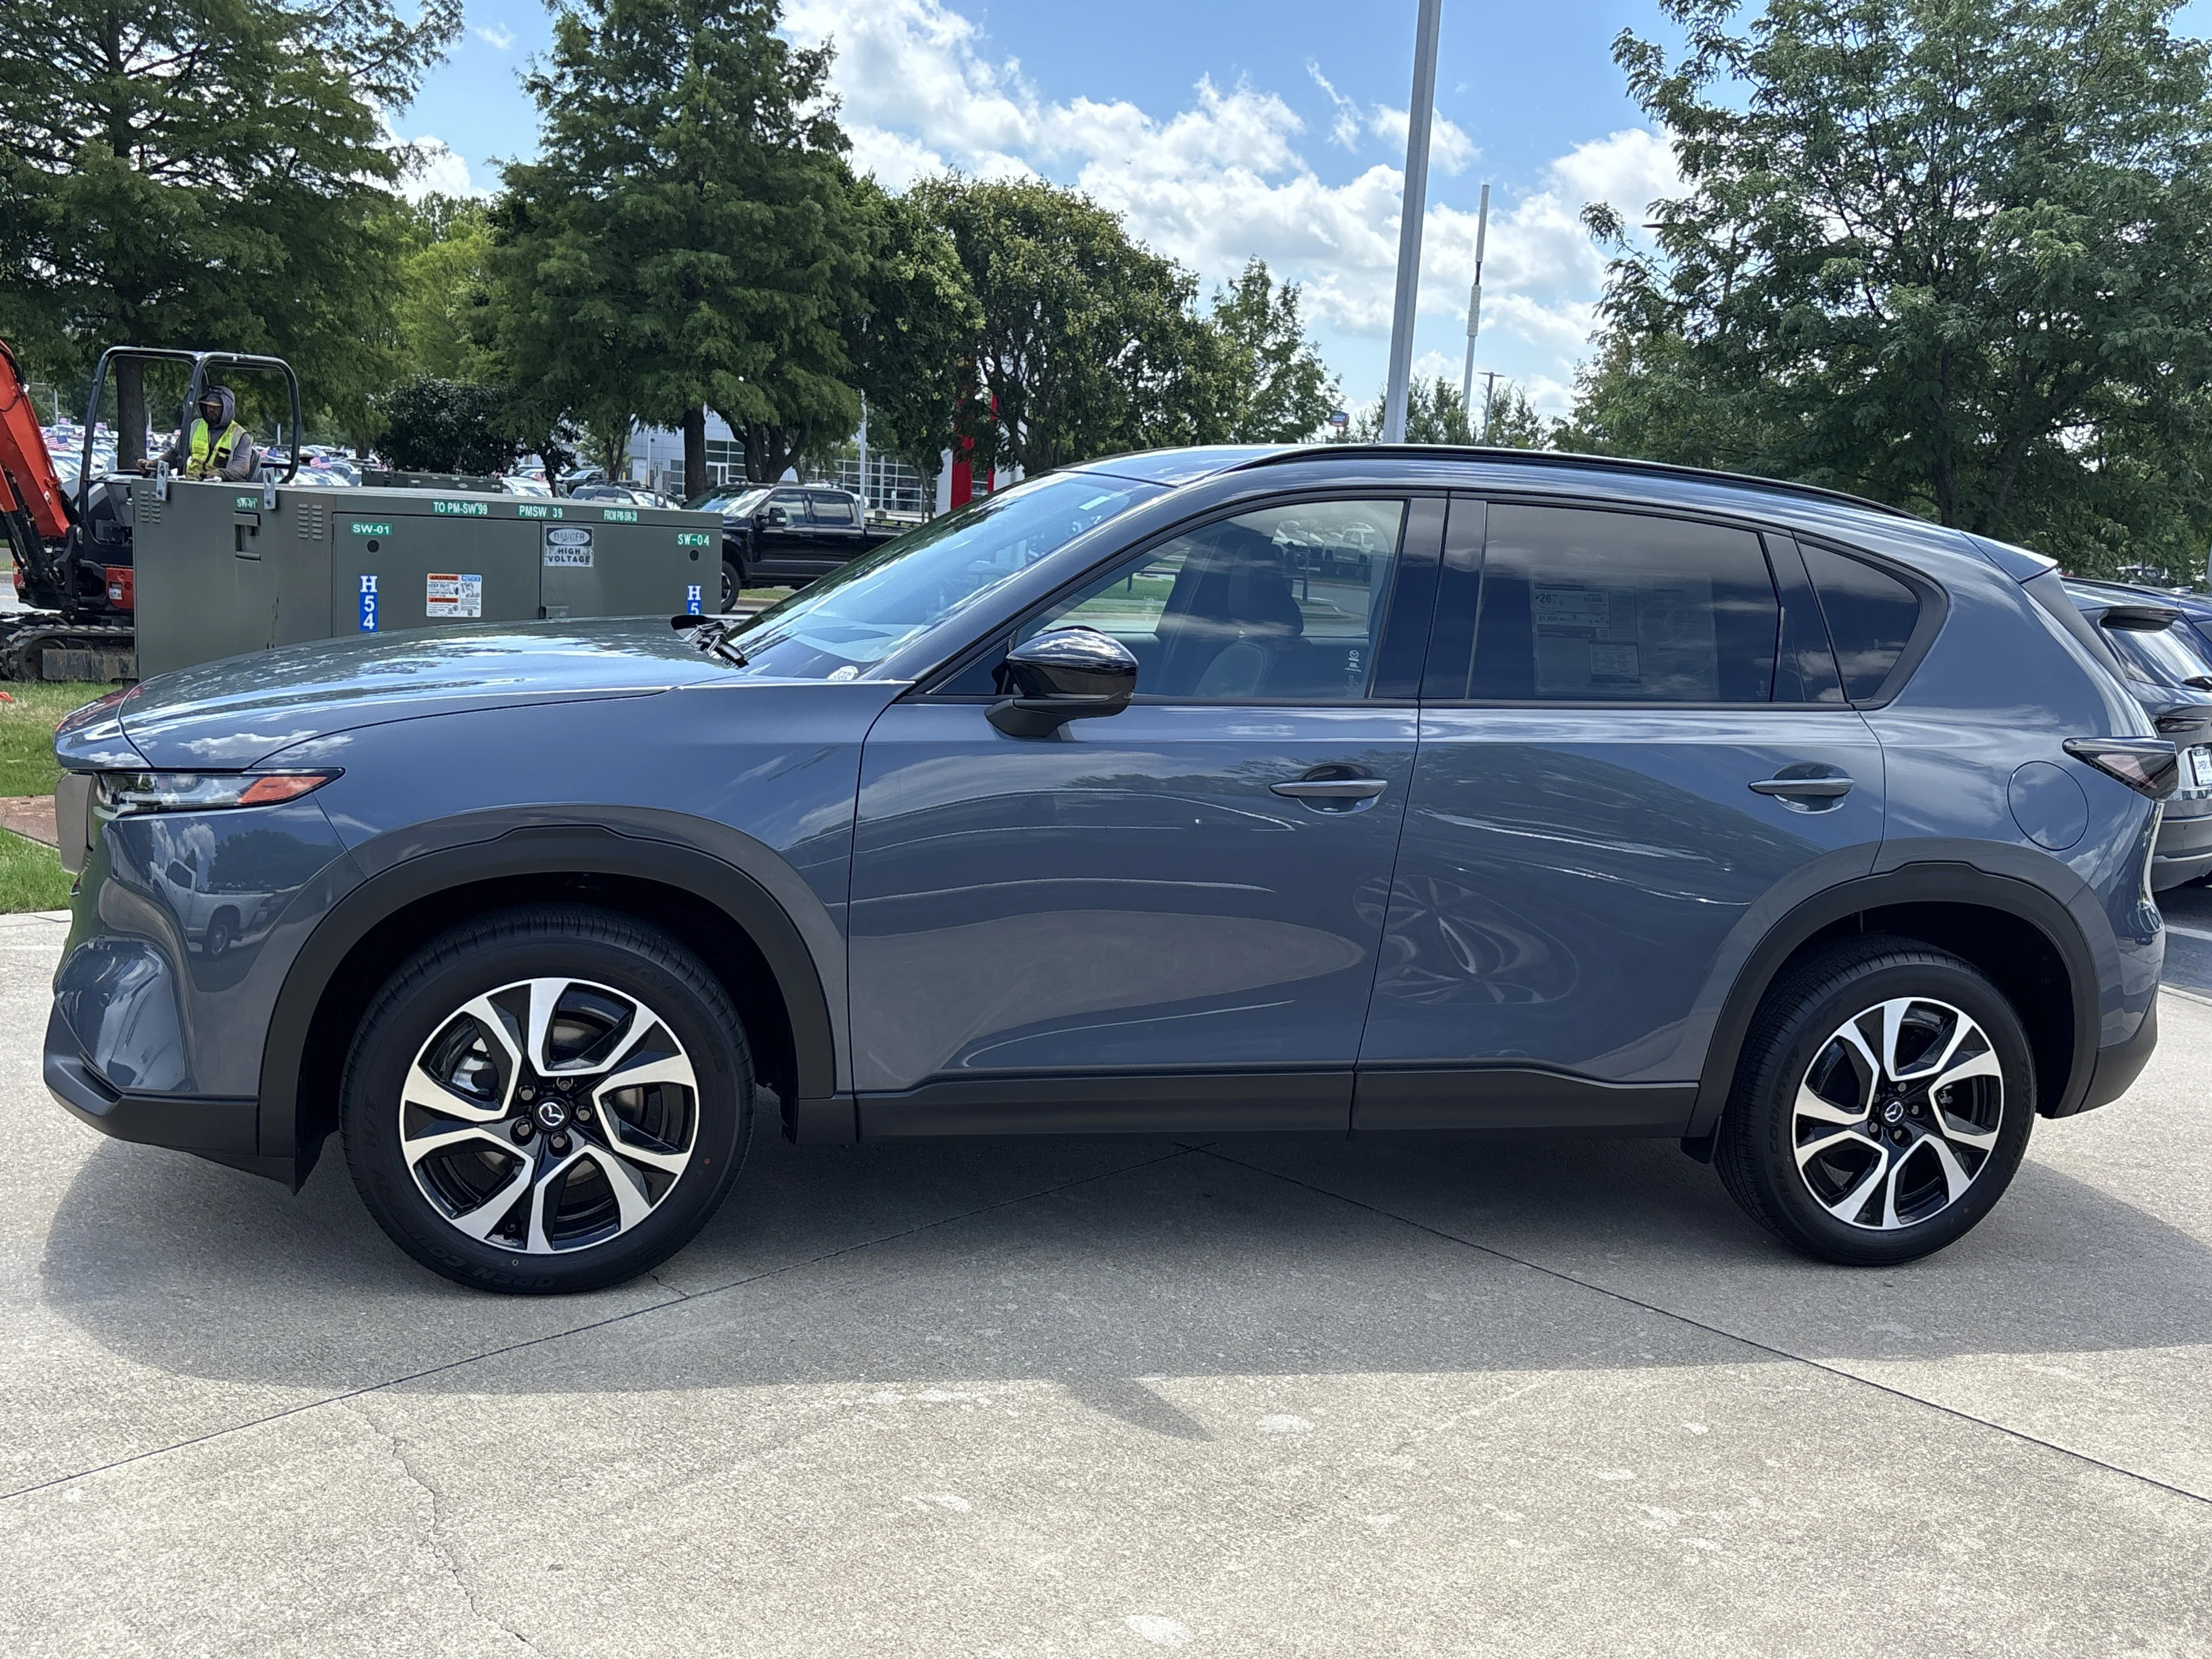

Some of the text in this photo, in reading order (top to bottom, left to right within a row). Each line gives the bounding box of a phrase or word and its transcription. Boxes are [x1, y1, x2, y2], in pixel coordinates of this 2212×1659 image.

[433, 501, 445, 512] TO
[519, 505, 563, 518] PMSW 39
[353, 524, 390, 534] SW-01
[554, 532, 585, 542] DANGER
[678, 533, 709, 546] SW-04
[1539, 594, 1551, 603] 26
[471, 1266, 558, 1287] OPEN
